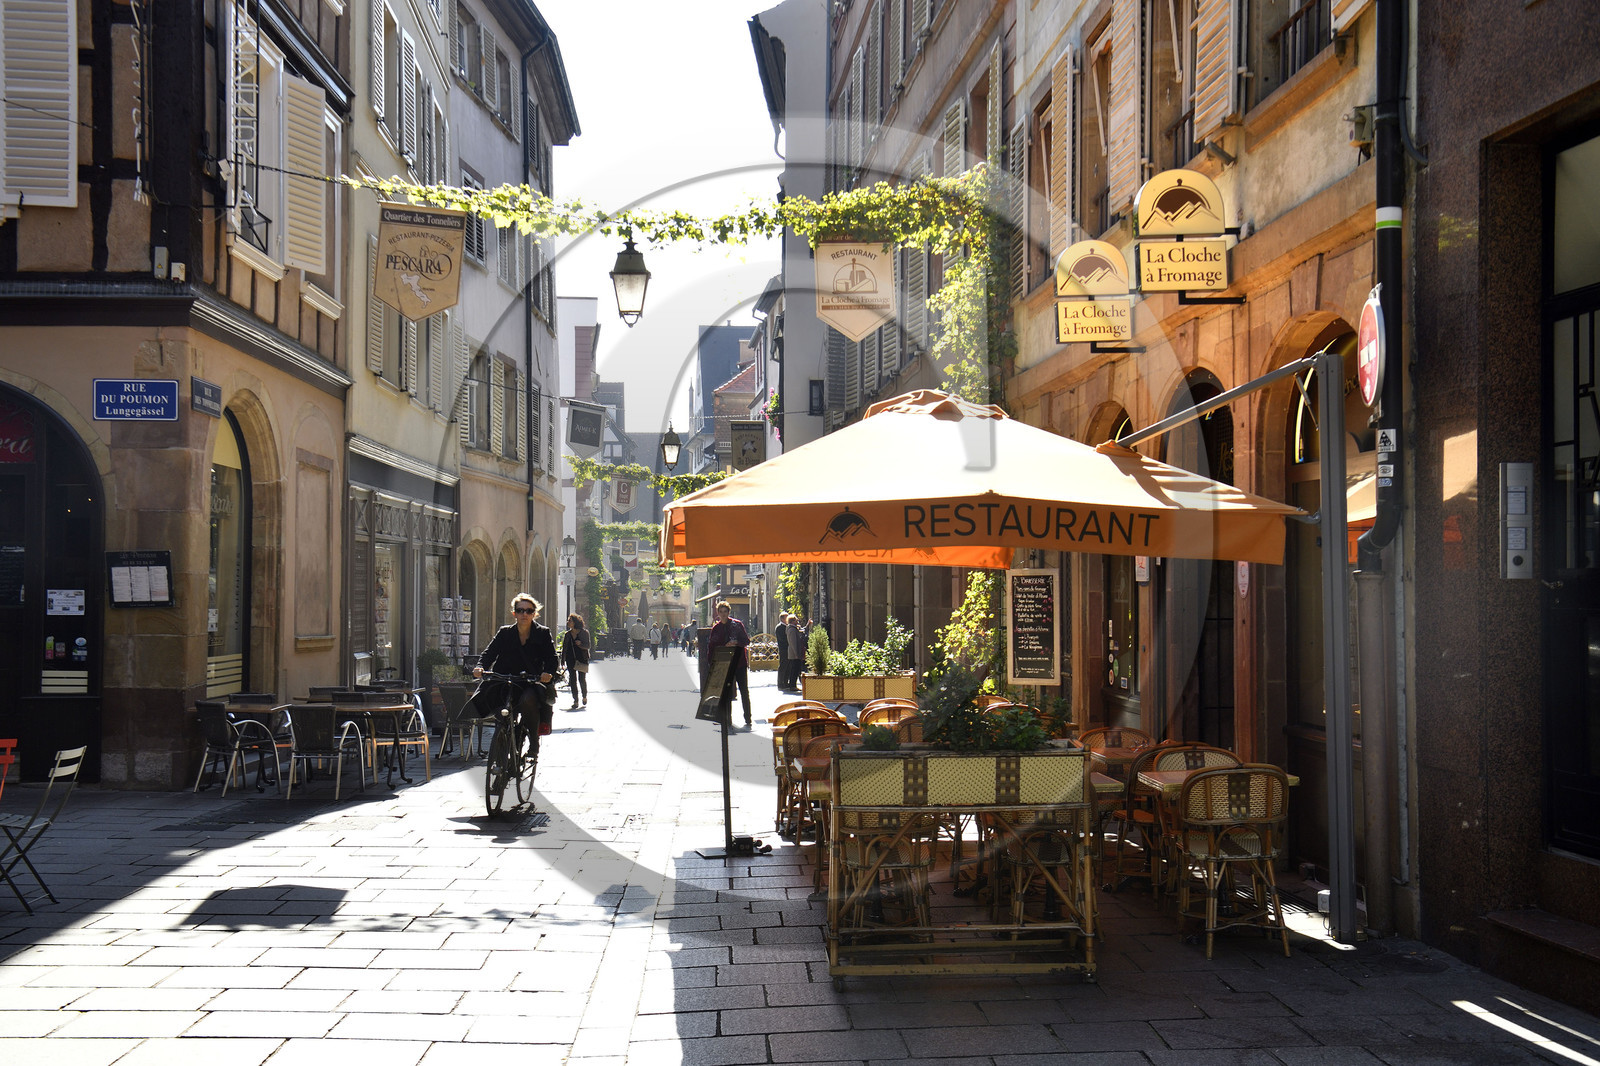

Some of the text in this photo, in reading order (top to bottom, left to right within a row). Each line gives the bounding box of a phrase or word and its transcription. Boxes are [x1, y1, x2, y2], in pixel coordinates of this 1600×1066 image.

[384, 210, 461, 227] Quartier des Tonneliers
[388, 232, 455, 252] RESTAURANT-PIZZERIA
[830, 249, 878, 260] RESTAURANT
[1146, 247, 1221, 263] La Cloche
[385, 254, 445, 274] PESCARA
[1146, 268, 1222, 286] à Fromage
[1064, 305, 1126, 319] La Cloche
[1064, 323, 1127, 337] à Fromage
[124, 384, 146, 392] RUE
[101, 395, 168, 404] DU POUMON
[106, 406, 164, 417] Lungegässel
[904, 504, 1160, 547] RESTAURANT
